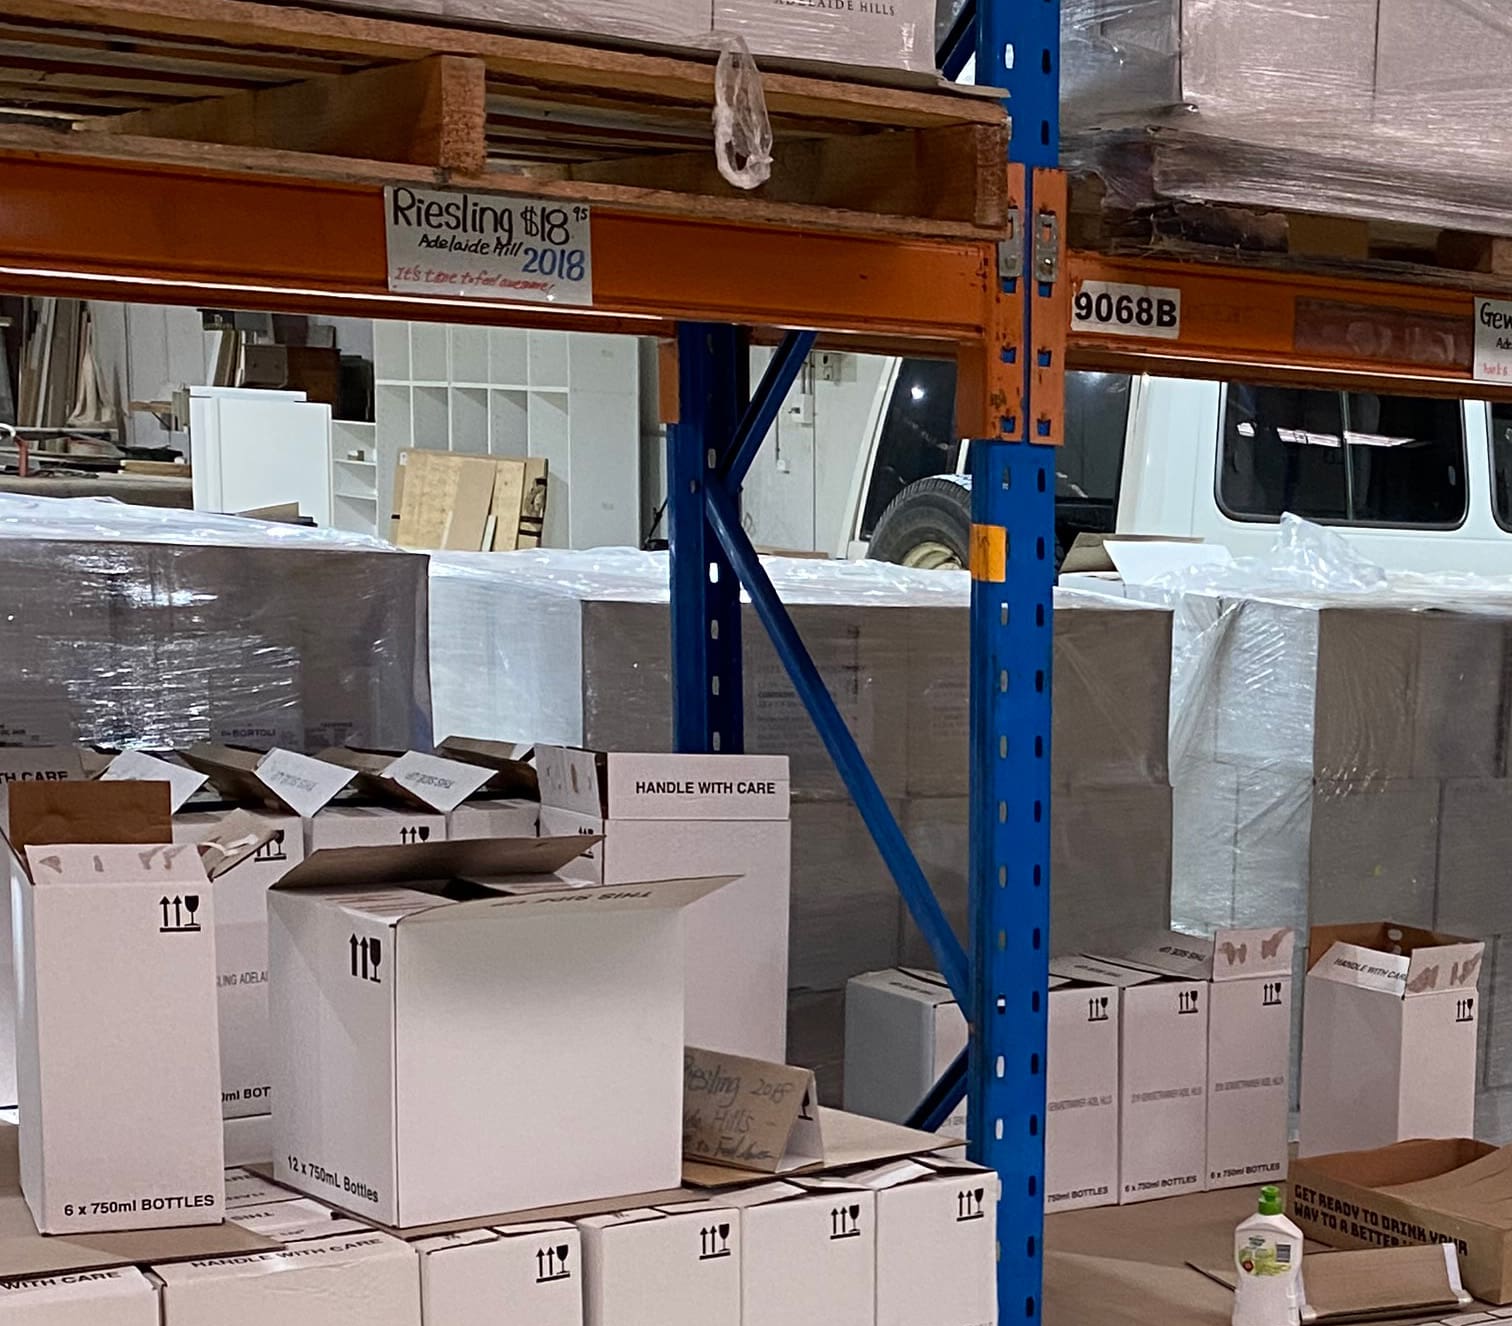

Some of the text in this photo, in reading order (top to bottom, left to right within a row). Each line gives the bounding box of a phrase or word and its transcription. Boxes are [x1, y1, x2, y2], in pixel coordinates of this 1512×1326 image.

[860, 3, 895, 17] HILLS
[393, 187, 513, 246] Riesling
[418, 233, 489, 255] Adelaide
[521, 247, 585, 282] 2018
[1074, 292, 1177, 328] 9068B
[635, 781, 776, 795] HANDLE WITH CARE
[1334, 957, 1388, 978] HANDLE WITH
[287, 1155, 379, 1203] 12 x 750mL Bottles
[1246, 1162, 1280, 1175] BOTTLES
[1071, 1185, 1109, 1199] BOTTLES
[1161, 1175, 1197, 1187] BOTTLES
[63, 1194, 215, 1217] 6 x 750ml BOTTLES
[1294, 1184, 1427, 1243] GET READY TO DRINK
[1294, 1202, 1319, 1224] WAY
[1320, 1211, 1337, 1230] TO
[1339, 1219, 1348, 1234] A
[191, 1237, 385, 1269] HANDLE WITH CARE
[61, 1271, 123, 1286] CARE
